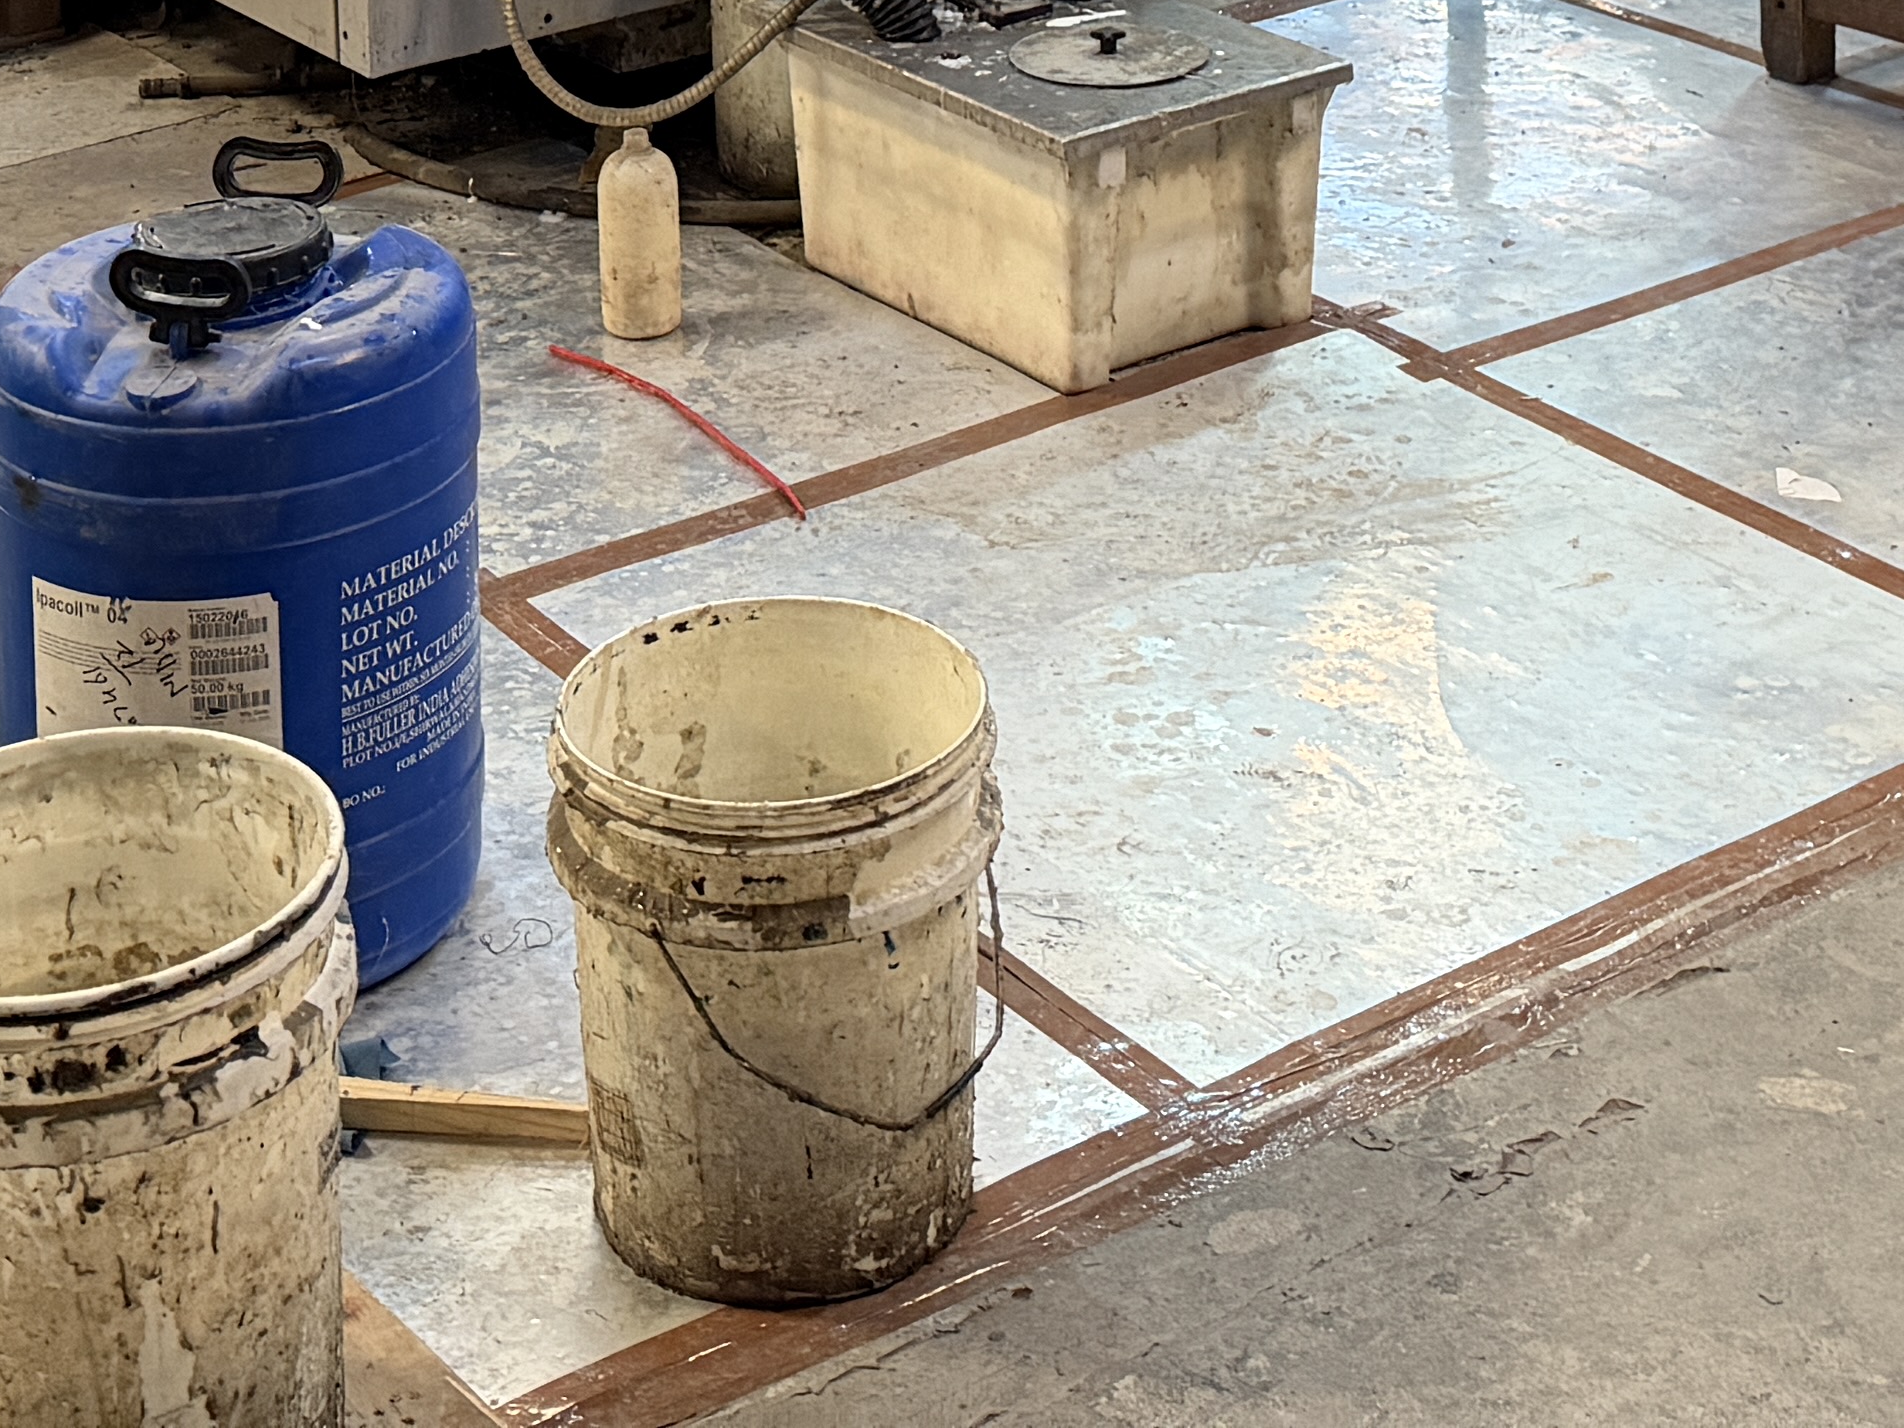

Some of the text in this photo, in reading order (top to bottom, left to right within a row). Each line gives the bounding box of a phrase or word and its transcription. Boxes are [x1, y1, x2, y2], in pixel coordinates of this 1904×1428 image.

[341, 538, 441, 599] MATERIAL
[341, 568, 435, 626] MATERIAL
[437, 550, 460, 580] NO.
[341, 606, 418, 652] LOT NO.
[341, 630, 418, 678] NET WT.
[341, 611, 471, 703] MANUFACTURED
[190, 681, 244, 694] 50.00 kg
[341, 704, 361, 718] BEST
[341, 709, 416, 757] H.B.FULLER
[418, 687, 450, 721] INDIA
[342, 698, 409, 736] MANUFACTURED
[342, 748, 374, 769] PLOT
[396, 754, 418, 772] FOR
